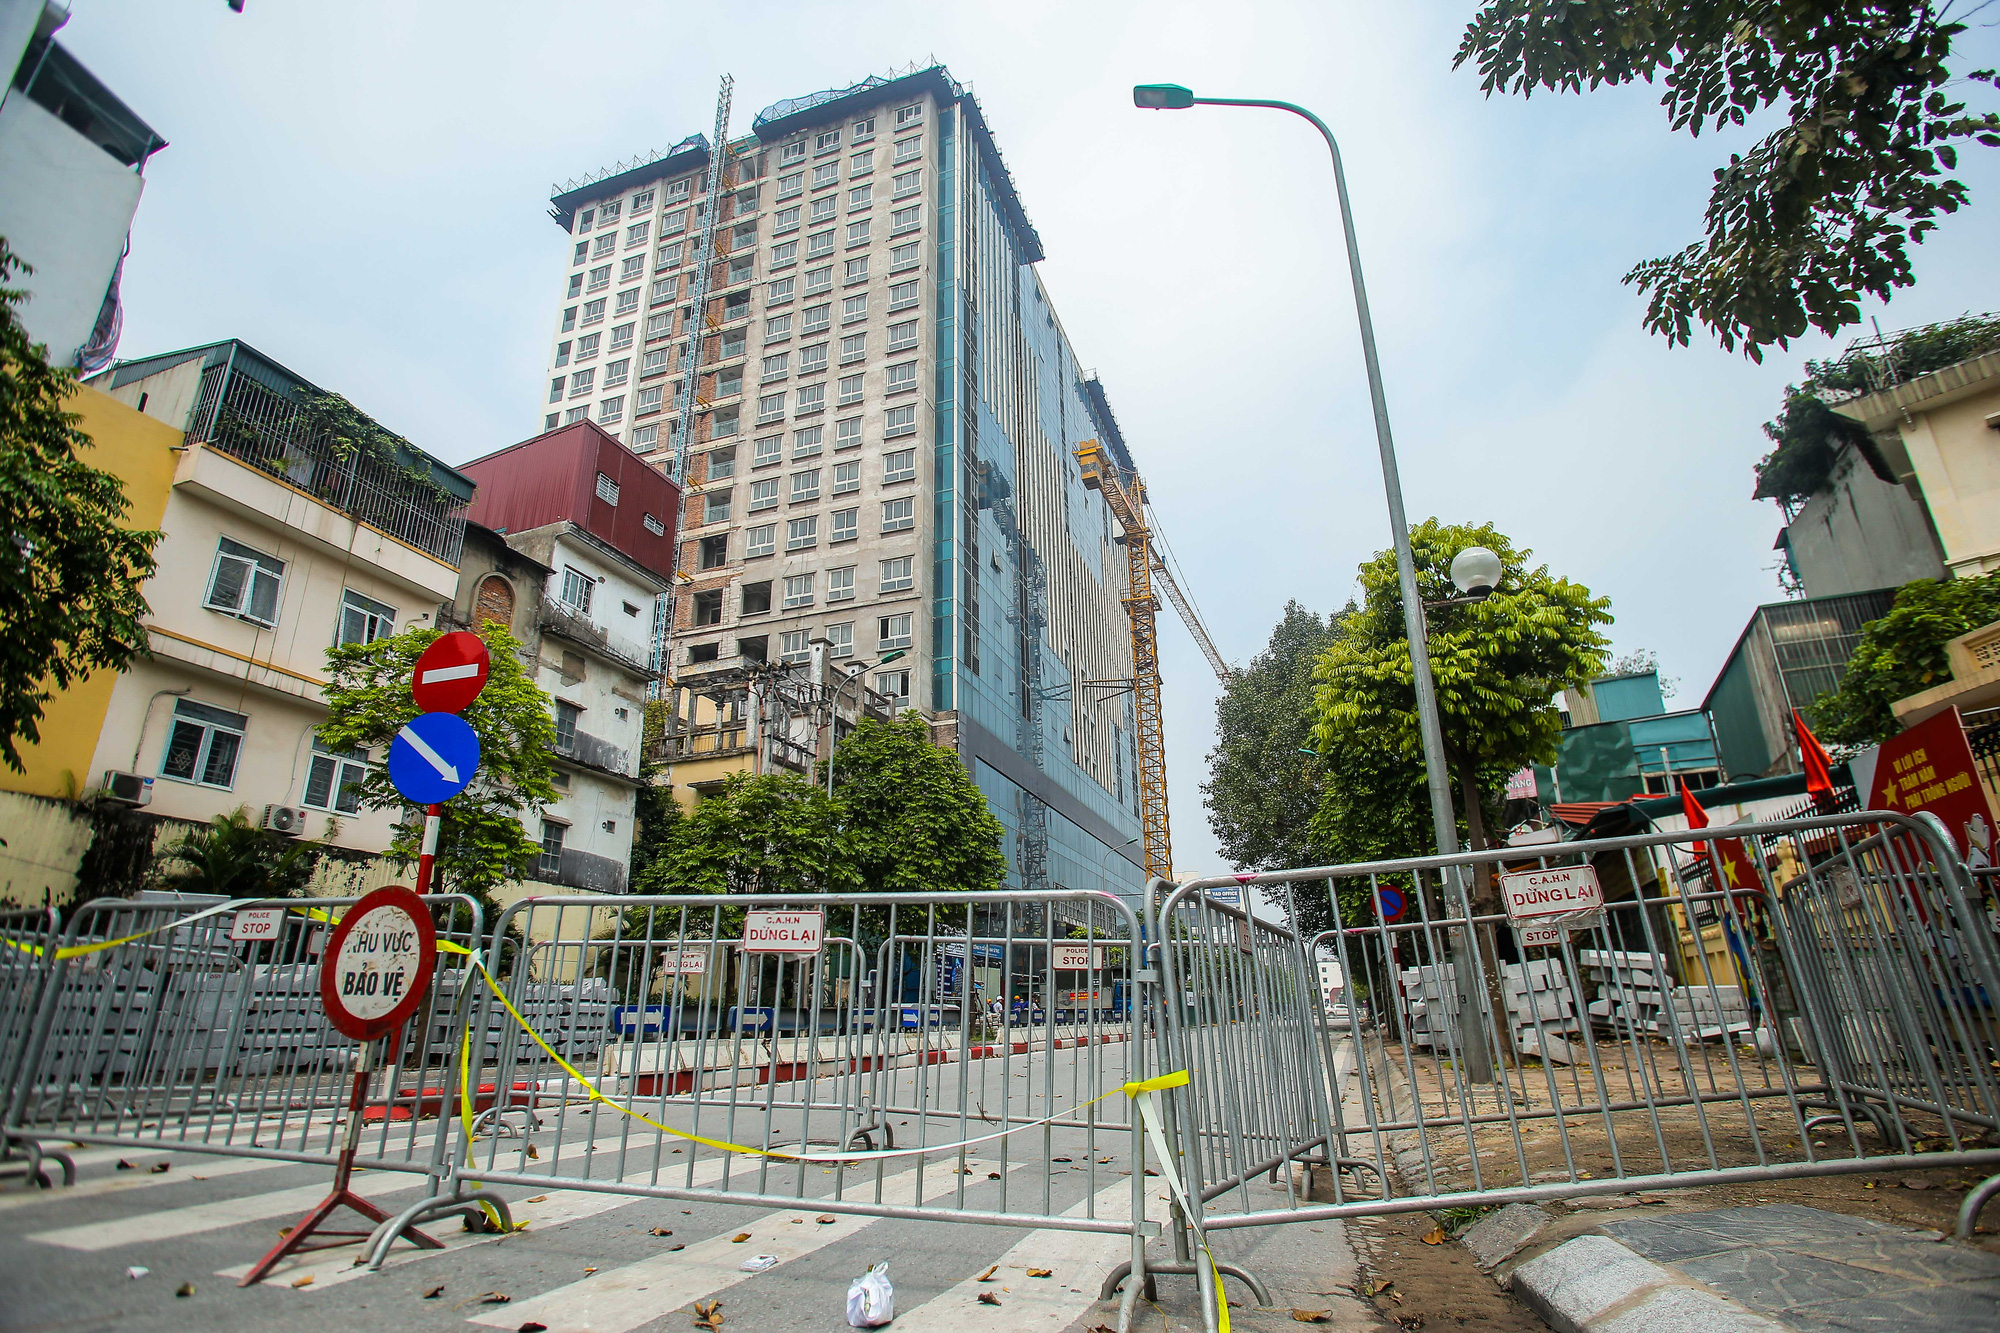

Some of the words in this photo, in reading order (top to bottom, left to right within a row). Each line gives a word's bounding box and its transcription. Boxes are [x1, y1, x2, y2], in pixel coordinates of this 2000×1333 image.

[1529, 873, 1571, 885] C.A.H.N
[1513, 888, 1563, 906] DỪNG
[1565, 885, 1594, 901] LẠI
[766, 916, 800, 924] C.A.H.N
[242, 923, 271, 934] STOP
[750, 926, 788, 941] DỪNG
[791, 929, 816, 944] LẠI
[1526, 930, 1558, 941] STOP
[343, 962, 379, 996] BẢO
[383, 966, 404, 1003] VỆ
